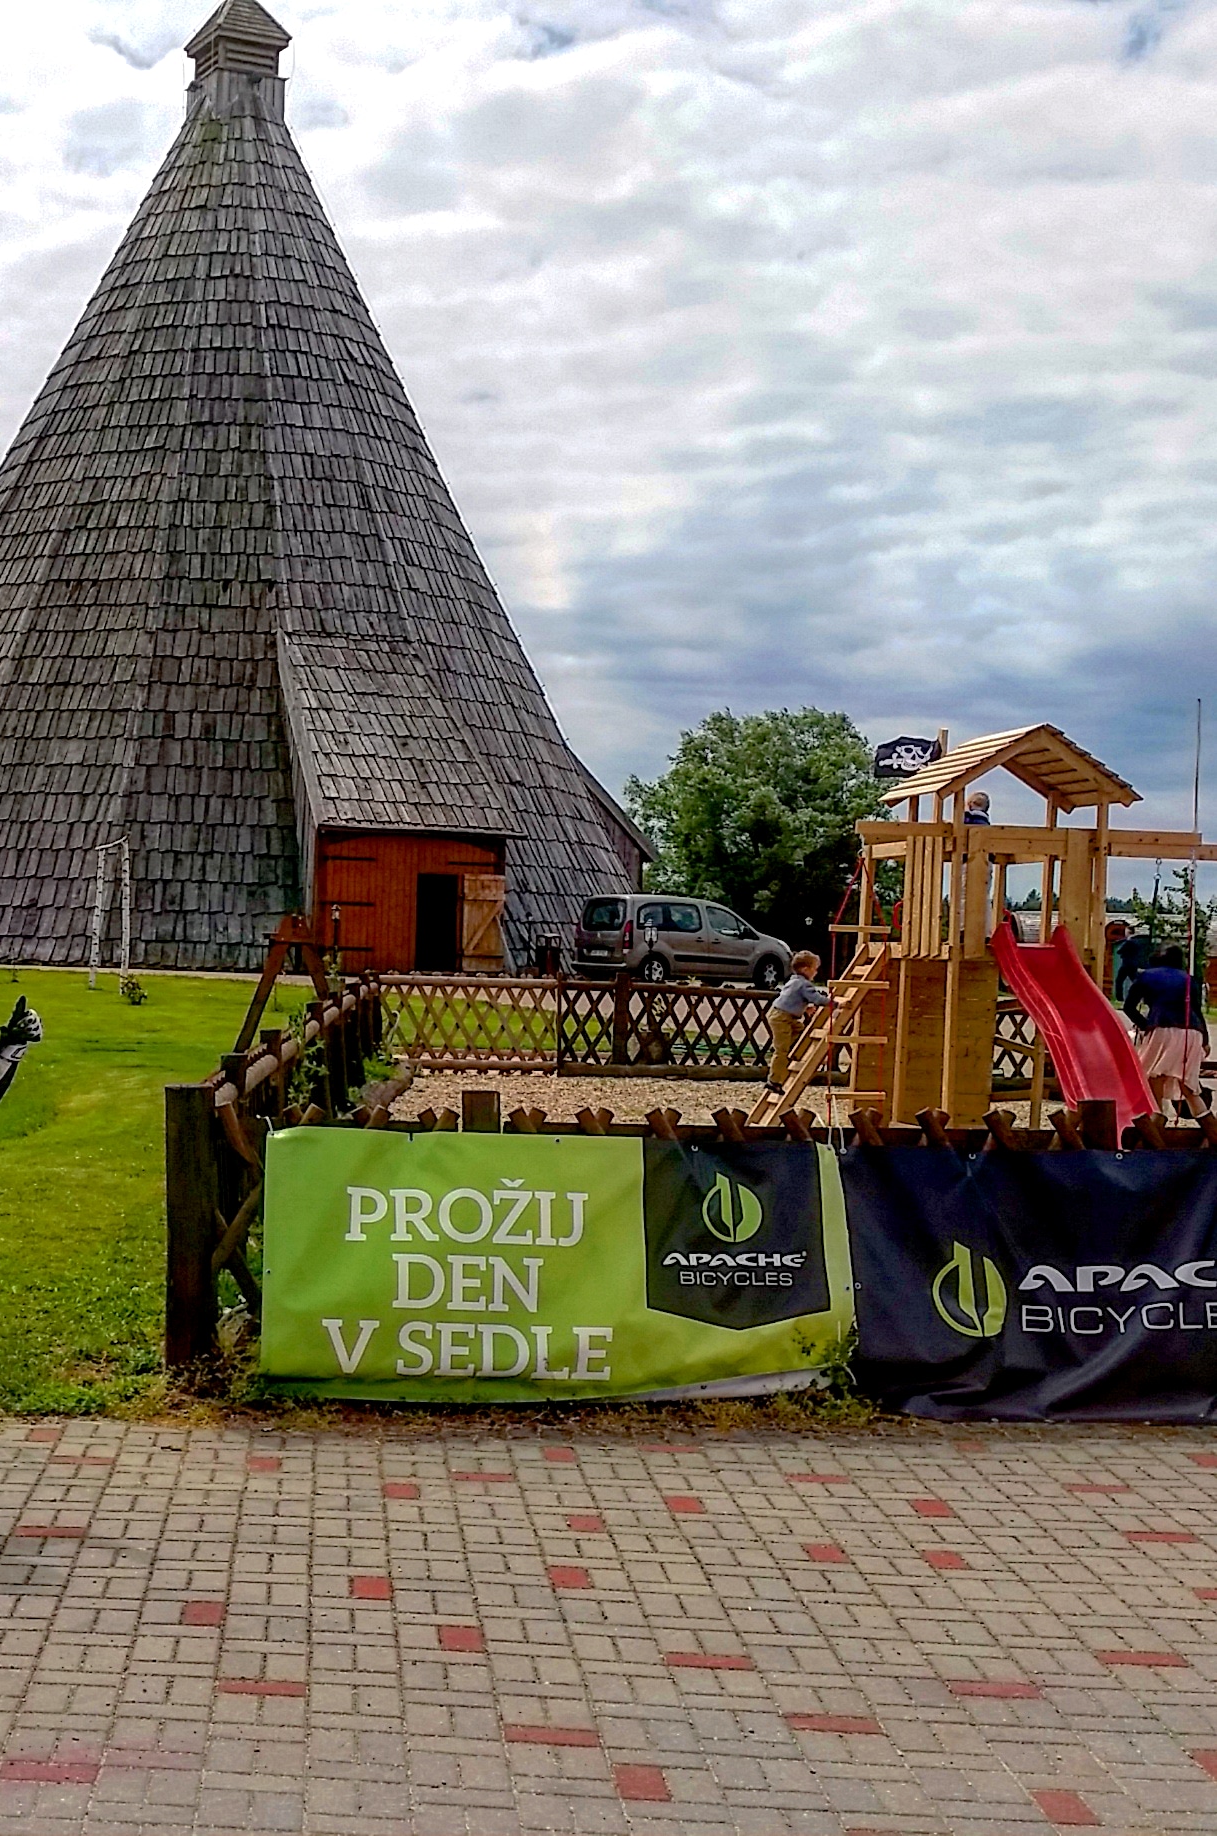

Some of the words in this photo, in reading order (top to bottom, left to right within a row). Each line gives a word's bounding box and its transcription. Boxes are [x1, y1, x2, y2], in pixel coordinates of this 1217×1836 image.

[344, 1178, 589, 1247] PROŽIJ
[391, 1253, 544, 1313] DEN
[662, 1252, 806, 1268] APACHE
[679, 1271, 793, 1287] BICYCLES
[321, 1318, 380, 1375] V
[396, 1320, 613, 1381] SEDLE
